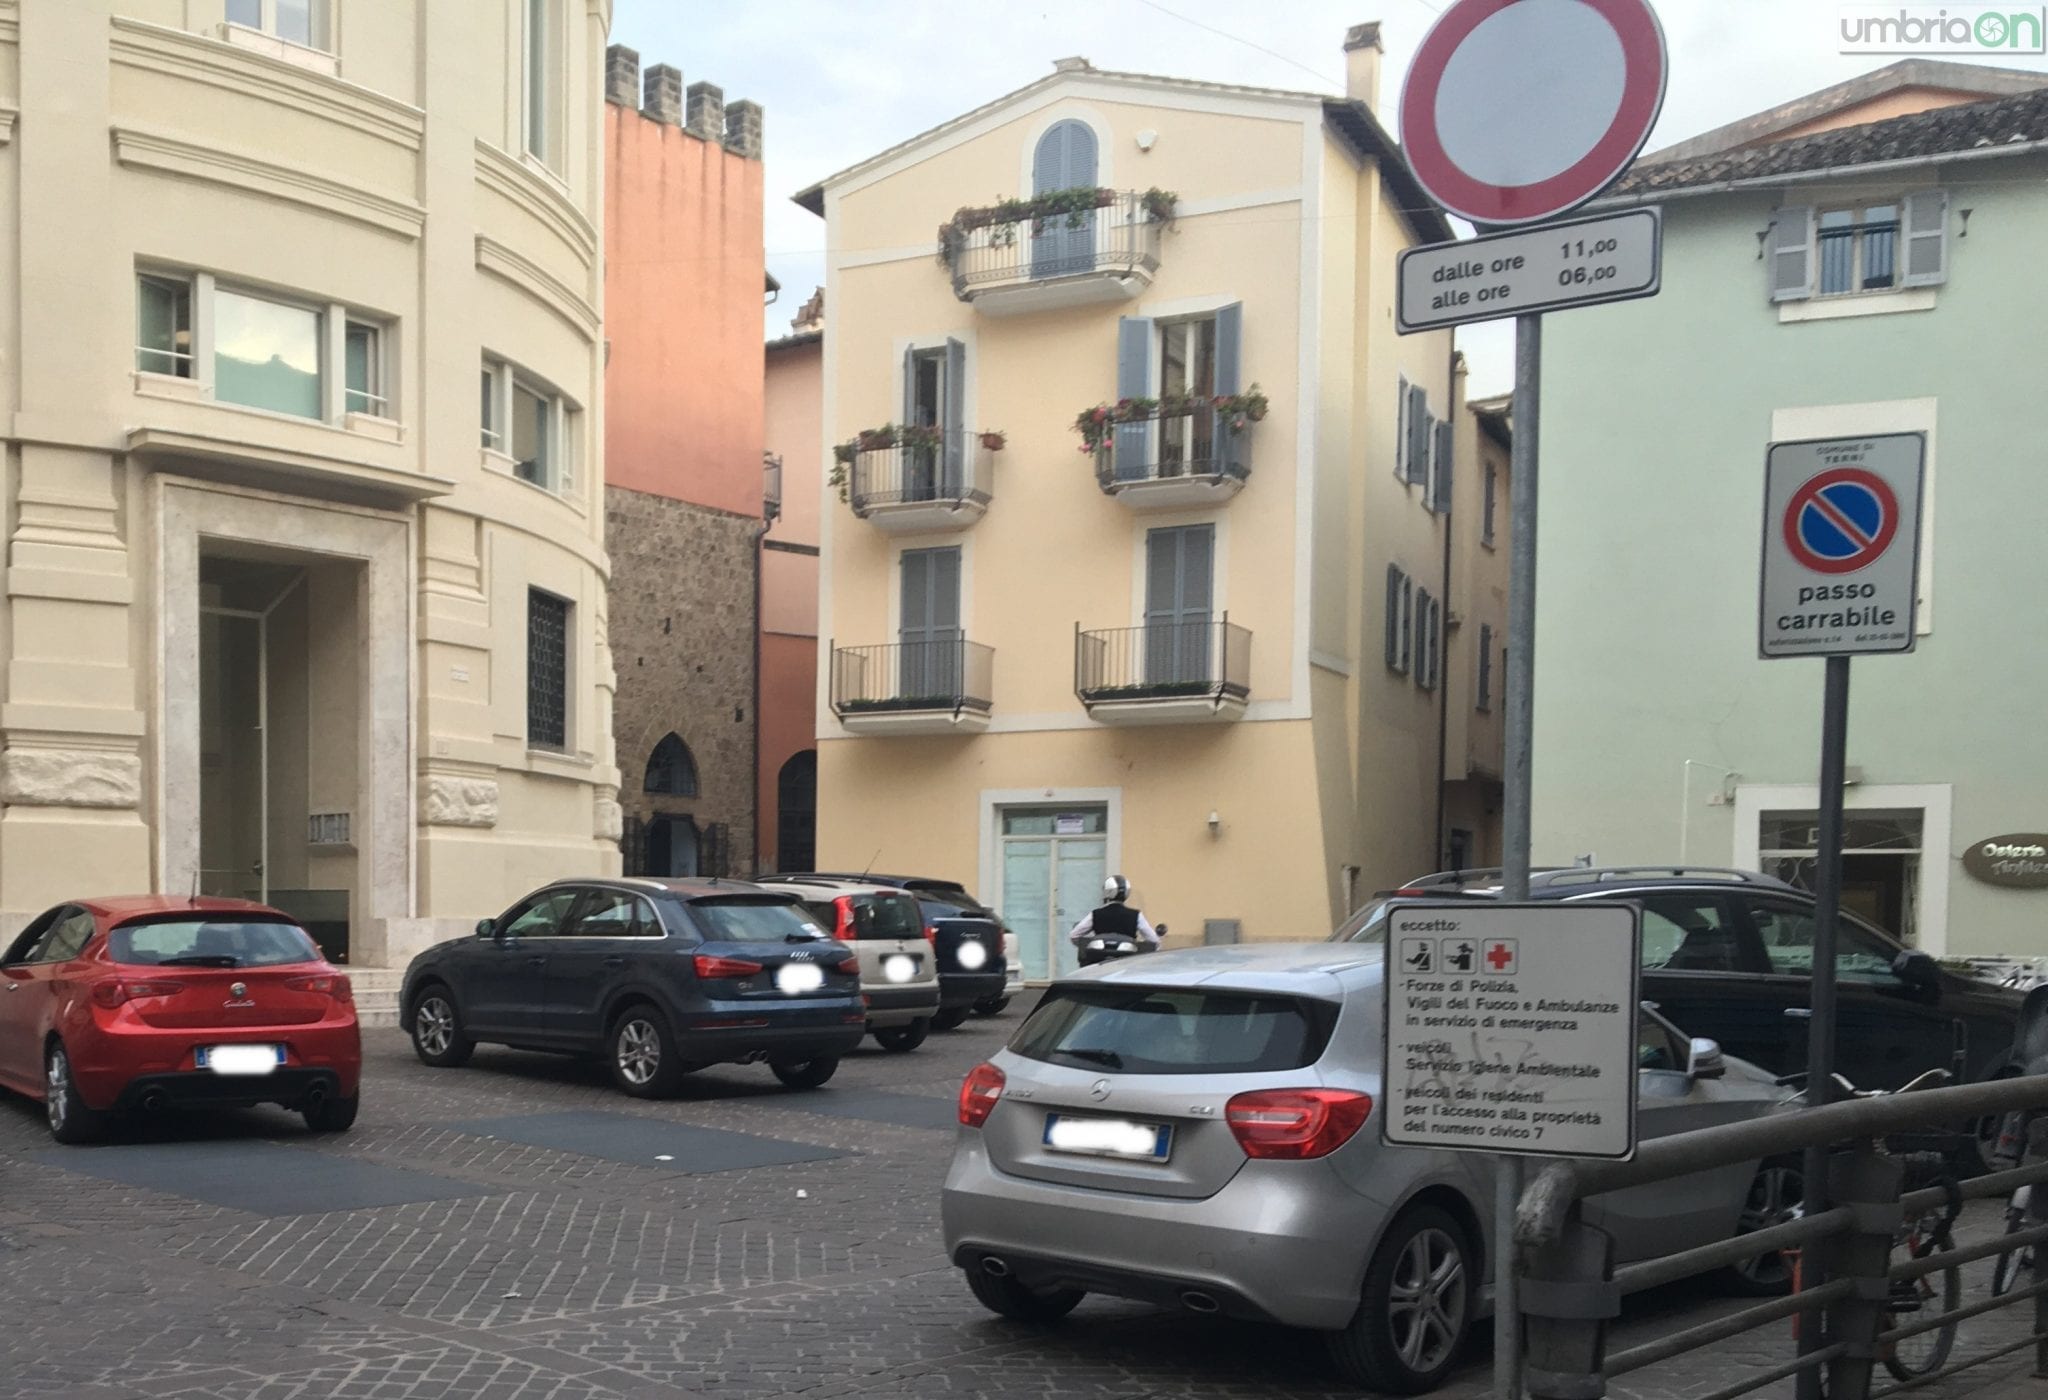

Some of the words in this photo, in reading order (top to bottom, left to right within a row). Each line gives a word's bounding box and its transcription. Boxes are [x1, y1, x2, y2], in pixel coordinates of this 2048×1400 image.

[1432, 261, 1484, 283] dalle
[1490, 255, 1525, 272] ore
[1560, 238, 1617, 259] 11,00
[1431, 289, 1470, 310] alle
[1477, 284, 1511, 302] ore
[1558, 265, 1616, 286] 06,00
[1799, 583, 1876, 605] passo
[1777, 606, 1896, 631] carrabile
[1400, 919, 1461, 932] eccetto:
[1450, 980, 1463, 992] di
[1408, 997, 1441, 1011] Vigili
[1476, 998, 1519, 1010] Fuoco
[1523, 1001, 1532, 1011] e
[1536, 999, 1619, 1013] Ambulanze
[1406, 1014, 1419, 1025] in
[1424, 1015, 1477, 1027] servizio
[1482, 1016, 1495, 1027] di
[1500, 1018, 1578, 1032] emergenza
[1406, 1058, 1461, 1071] Servizio
[1469, 1061, 1511, 1075] Igiene
[1517, 1062, 1601, 1078] Ambientale
[1405, 1086, 1450, 1099] veicoli
[1456, 1088, 1478, 1099] dei
[1482, 1090, 1544, 1103] residenti
[1404, 1105, 1427, 1117] per
[1501, 1108, 1527, 1120] alla
[1404, 1120, 1426, 1132] del
[1431, 1124, 1485, 1135] numero
[1489, 1125, 1530, 1139] civico
[1534, 1127, 1544, 1139] 7
